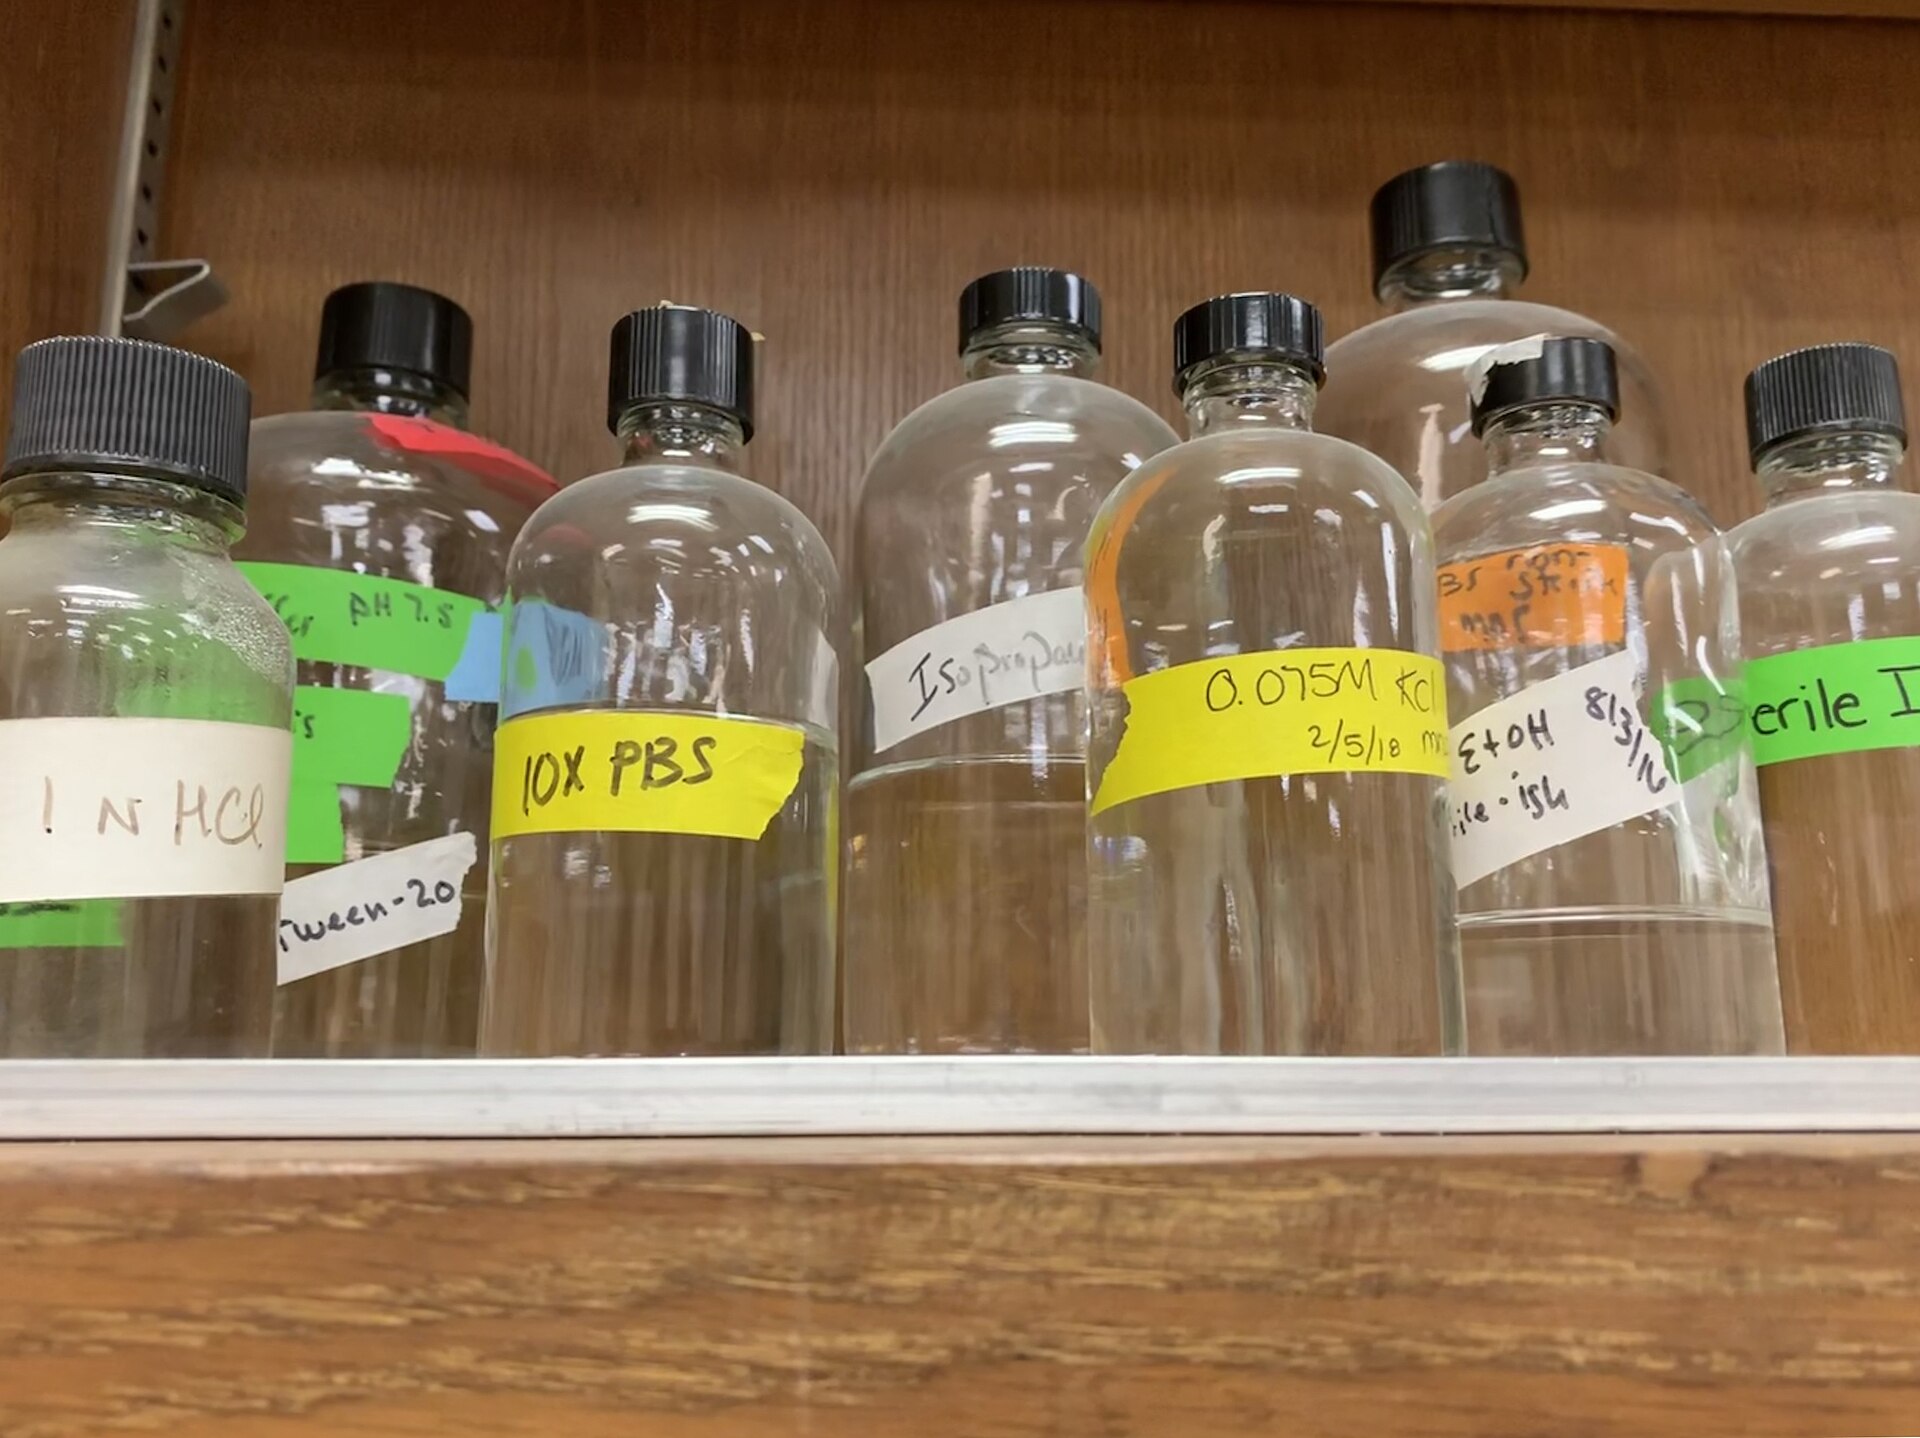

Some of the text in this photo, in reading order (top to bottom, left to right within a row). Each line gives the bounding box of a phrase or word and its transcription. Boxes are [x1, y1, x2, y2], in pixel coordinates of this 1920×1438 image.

[403, 592, 454, 629] 7.5
[1206, 658, 1378, 712] 0.075M
[1751, 678, 1868, 735] erile
[1307, 718, 1401, 766] 2/5/18
[1457, 708, 1555, 775] EtOH
[522, 736, 717, 817] 10X PBS
[43, 776, 266, 850] 1 N HCl
